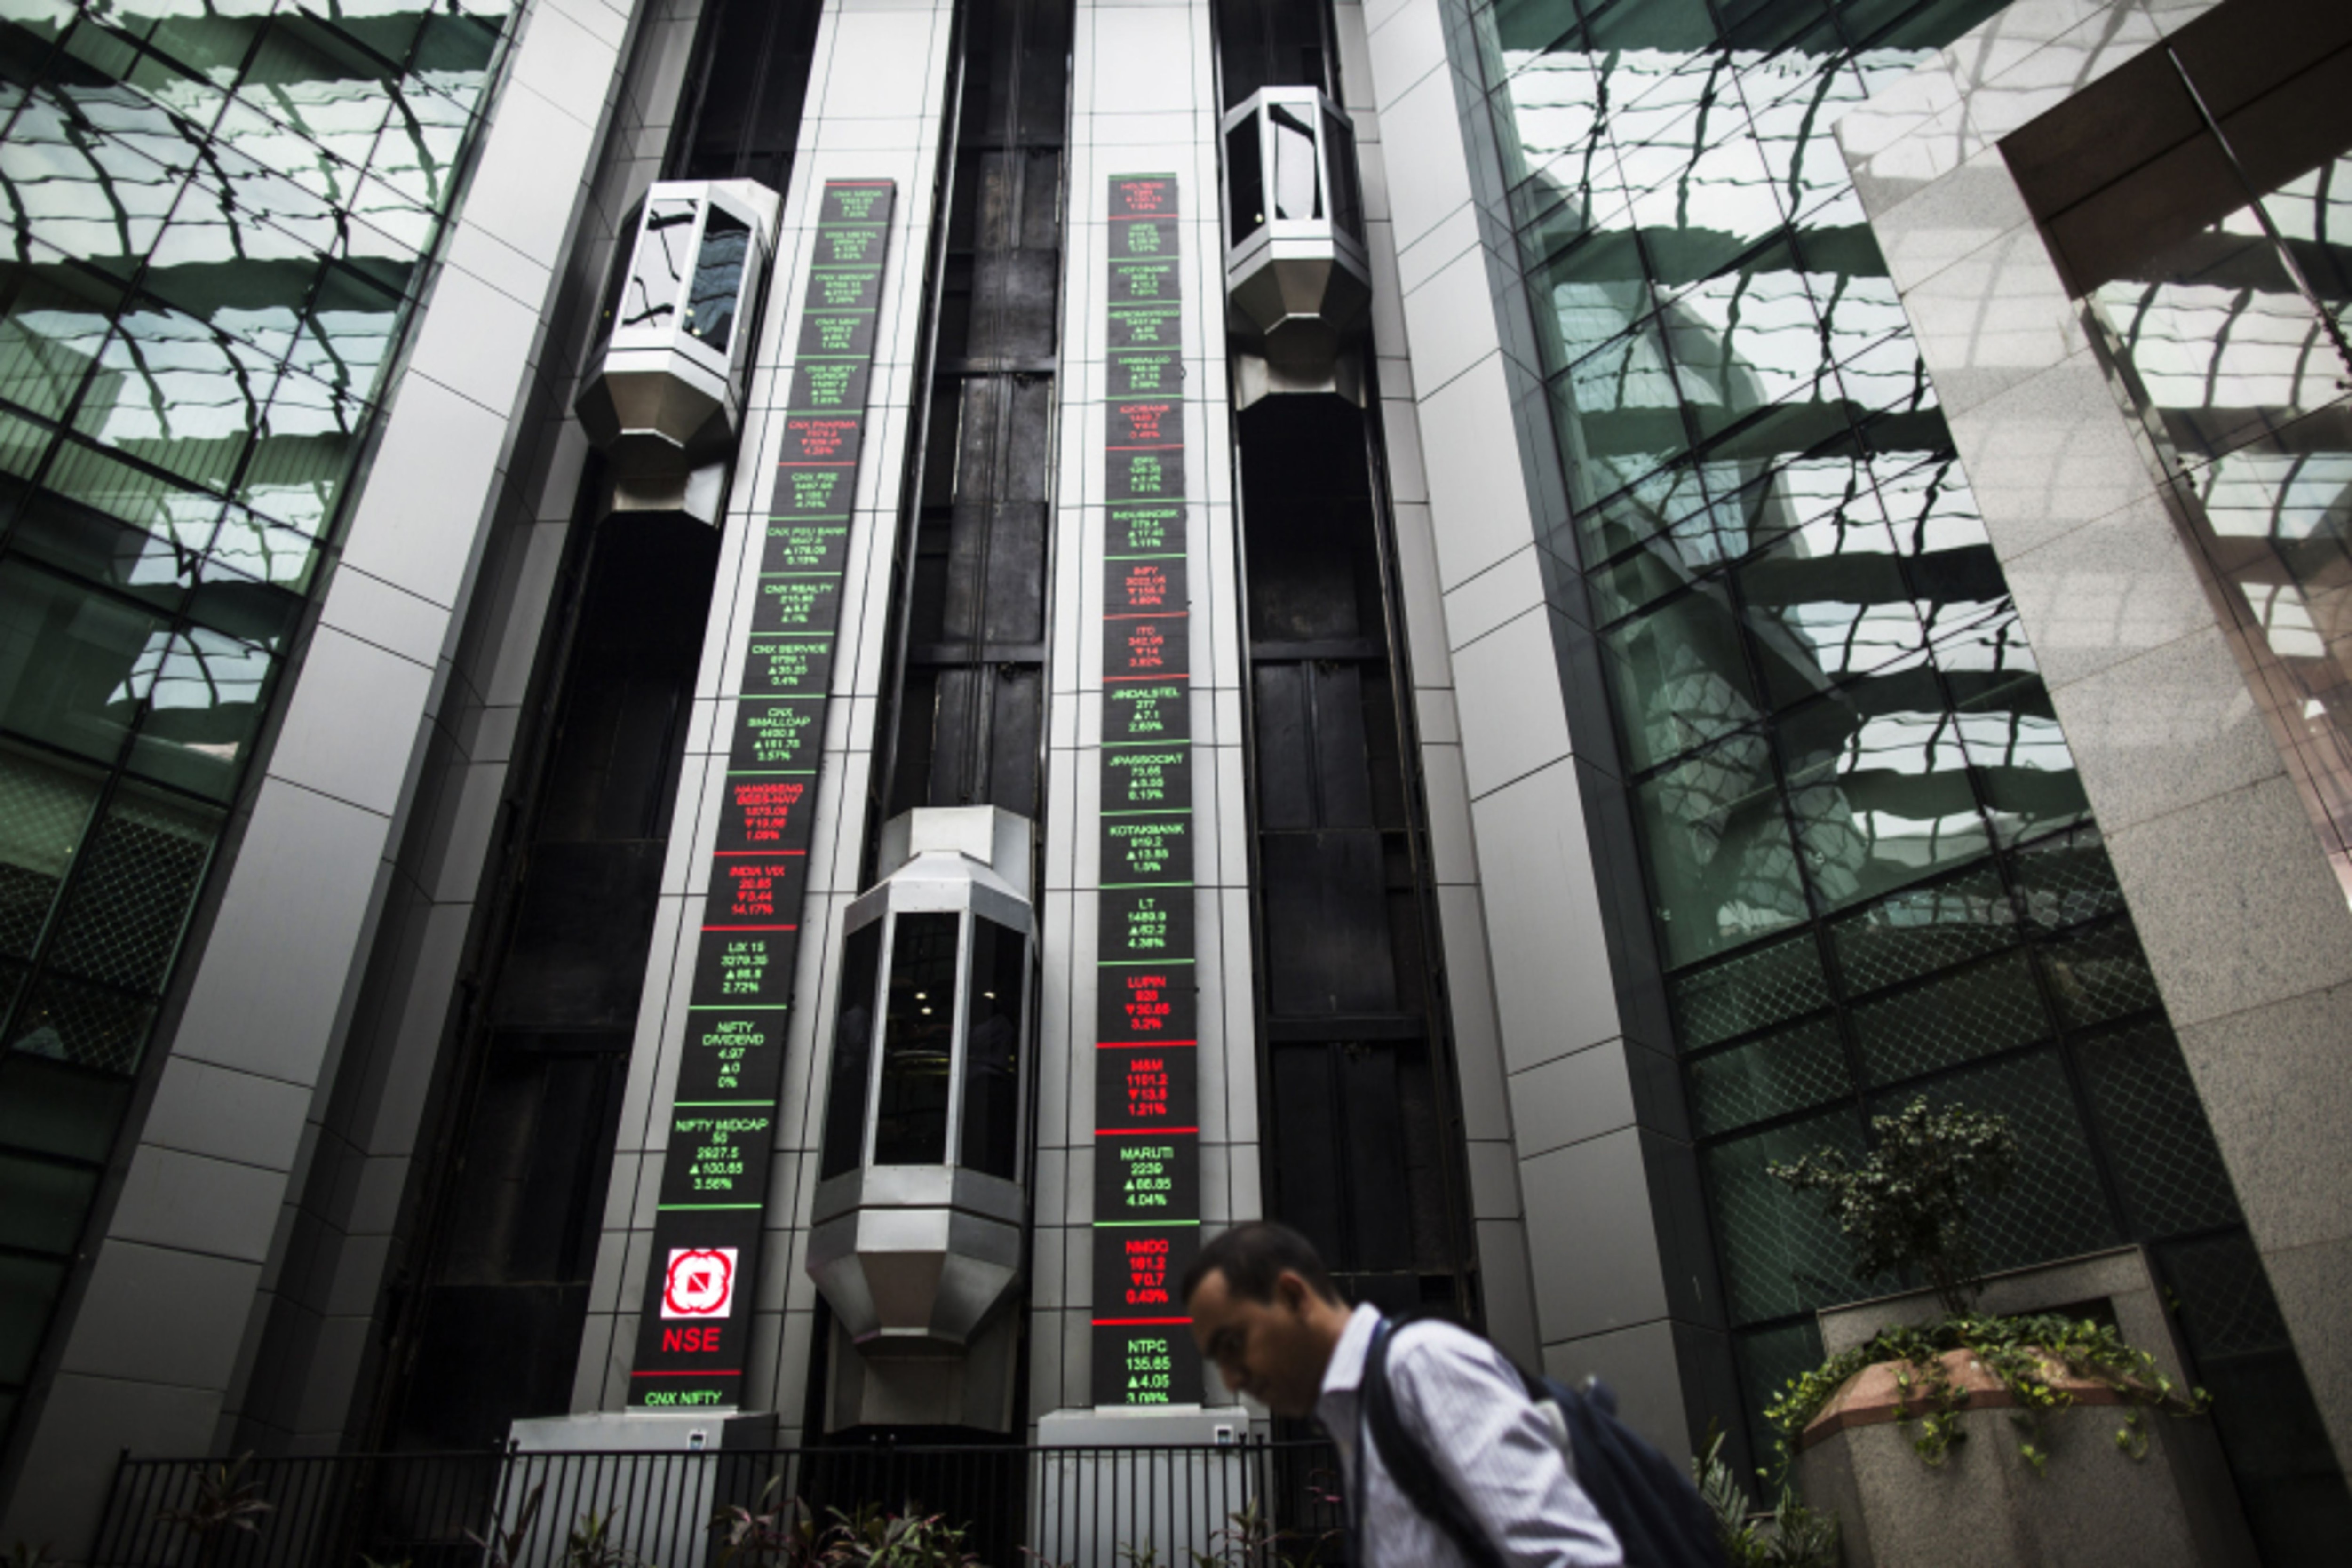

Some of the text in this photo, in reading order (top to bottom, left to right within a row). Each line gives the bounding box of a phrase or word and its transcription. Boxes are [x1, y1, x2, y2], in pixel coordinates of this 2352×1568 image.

[730, 866, 784, 877] INDIA VIX
[1139, 899, 1154, 909] LT
[752, 942, 764, 952] 15
[1128, 976, 1165, 987] LUPIN
[717, 1022, 753, 1032] NIFTY
[703, 1032, 764, 1045] DIVIDEND
[718, 1076, 737, 1087] 0%
[675, 1118, 768, 1132] NIFTY MIDCAP
[1121, 1147, 1173, 1159] MARUTI
[1127, 1194, 1166, 1205] 4.04%
[1126, 1240, 1168, 1254] NMDC
[1144, 1271, 1164, 1286] 0.7
[662, 1327, 721, 1352] NSE
[1128, 1339, 1166, 1352] NTPC
[1139, 1374, 1169, 1386] 4.05
[645, 1390, 722, 1405] CNX NIFTY
